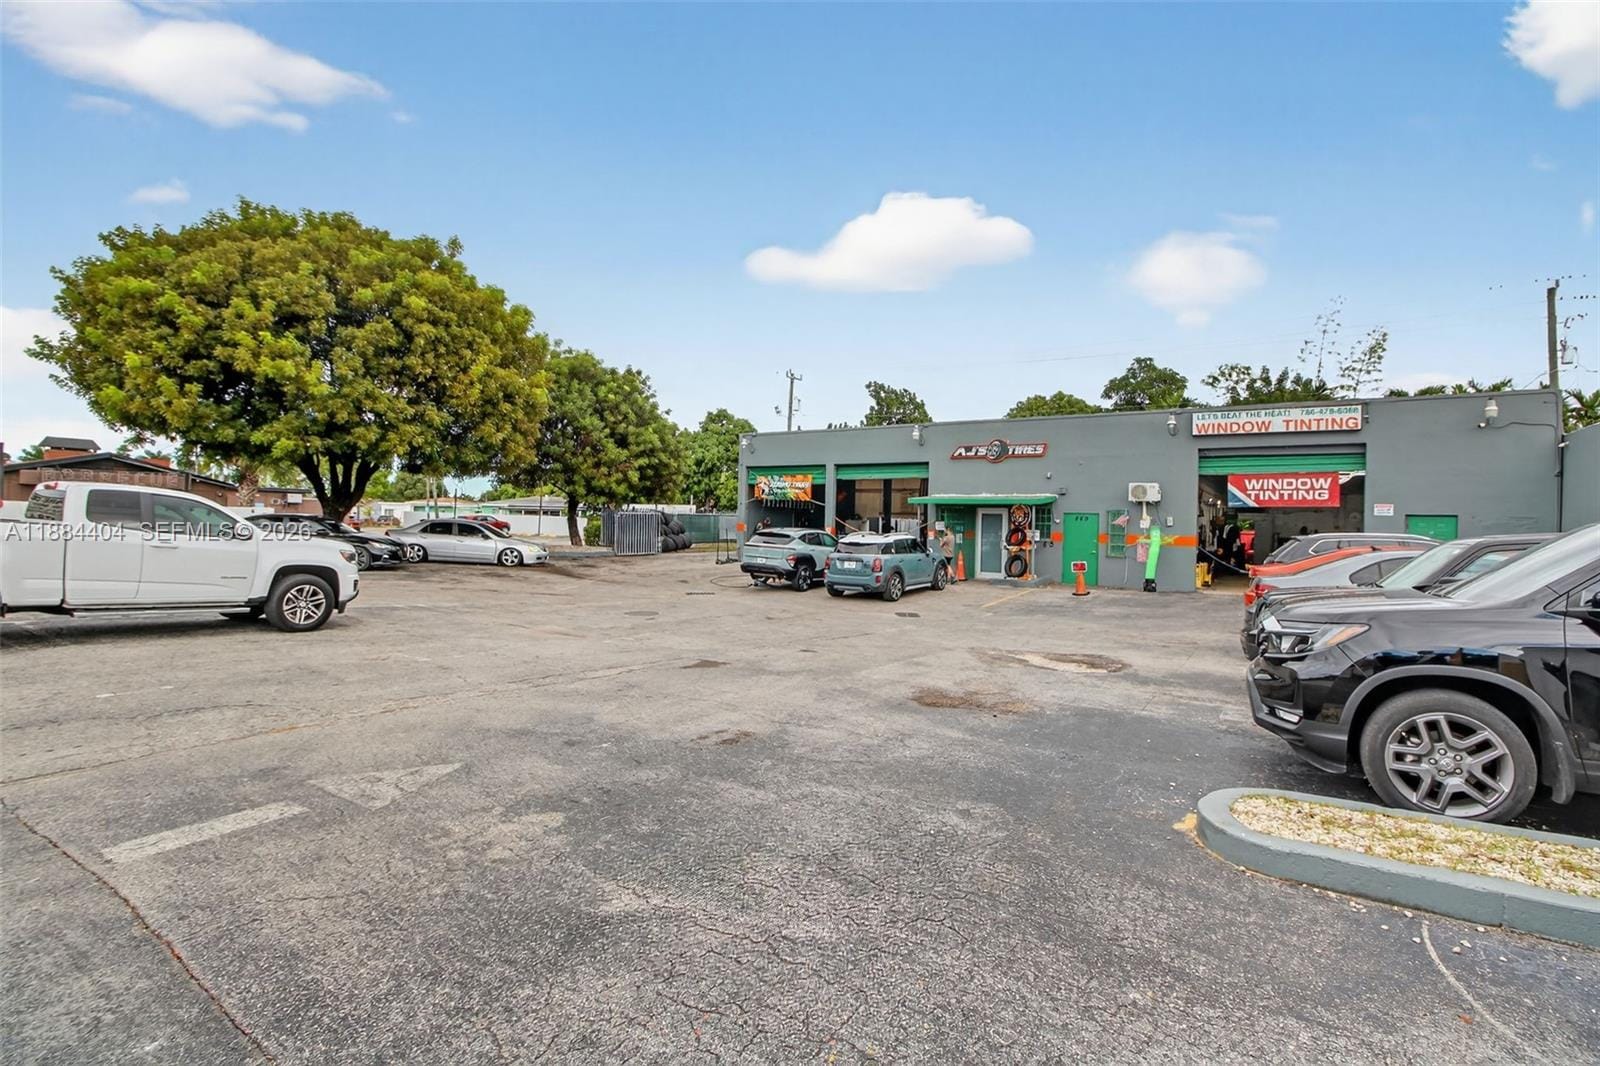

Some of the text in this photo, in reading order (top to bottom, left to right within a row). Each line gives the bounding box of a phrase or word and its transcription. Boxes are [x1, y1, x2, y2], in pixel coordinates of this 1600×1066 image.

[1220, 412, 1242, 420] BEAT
[1245, 411, 1263, 419] THE
[1196, 417, 1359, 434] WINDOW TINTING
[1007, 445, 1044, 455] TIRES
[1244, 478, 1332, 490] WINDOW
[1246, 490, 1329, 500] TINTING
